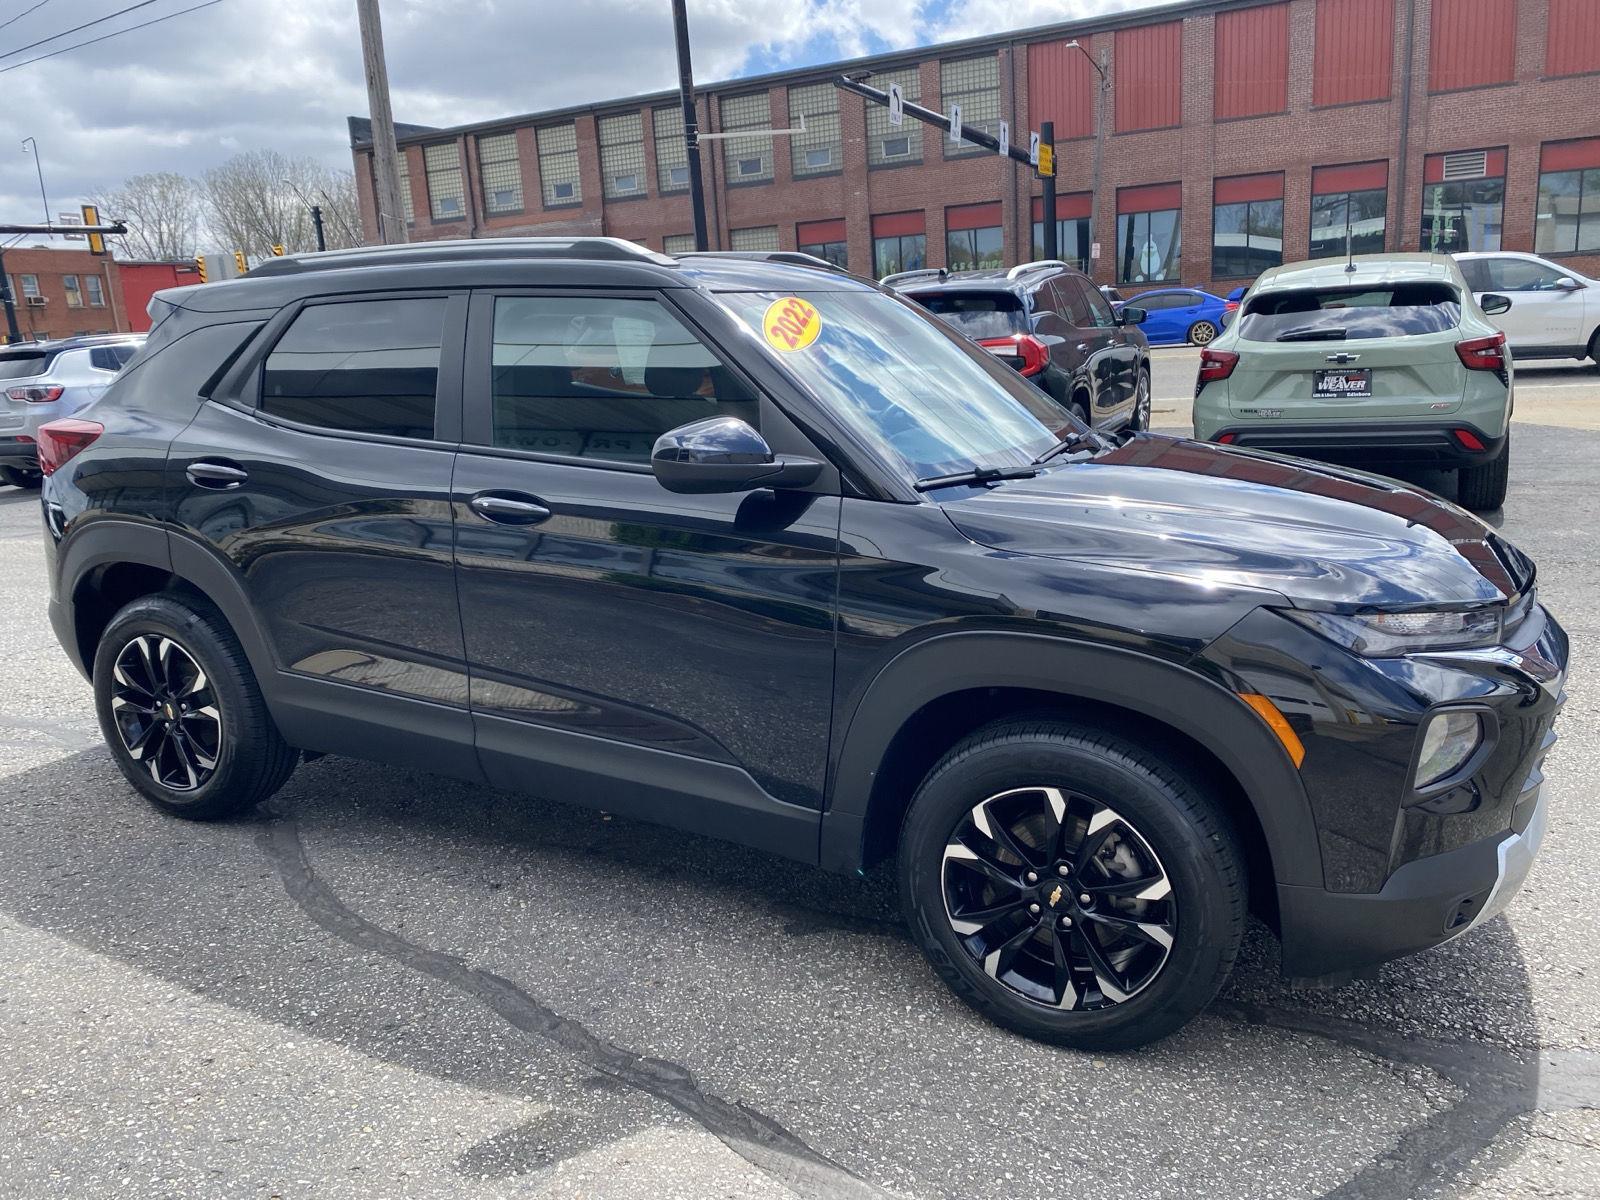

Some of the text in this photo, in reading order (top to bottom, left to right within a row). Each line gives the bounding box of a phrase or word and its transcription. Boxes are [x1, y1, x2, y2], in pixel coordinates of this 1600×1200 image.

[770, 299, 814, 349] 2022
[1318, 380, 1367, 391] WEAVER
[1323, 375, 1347, 385] RICK
